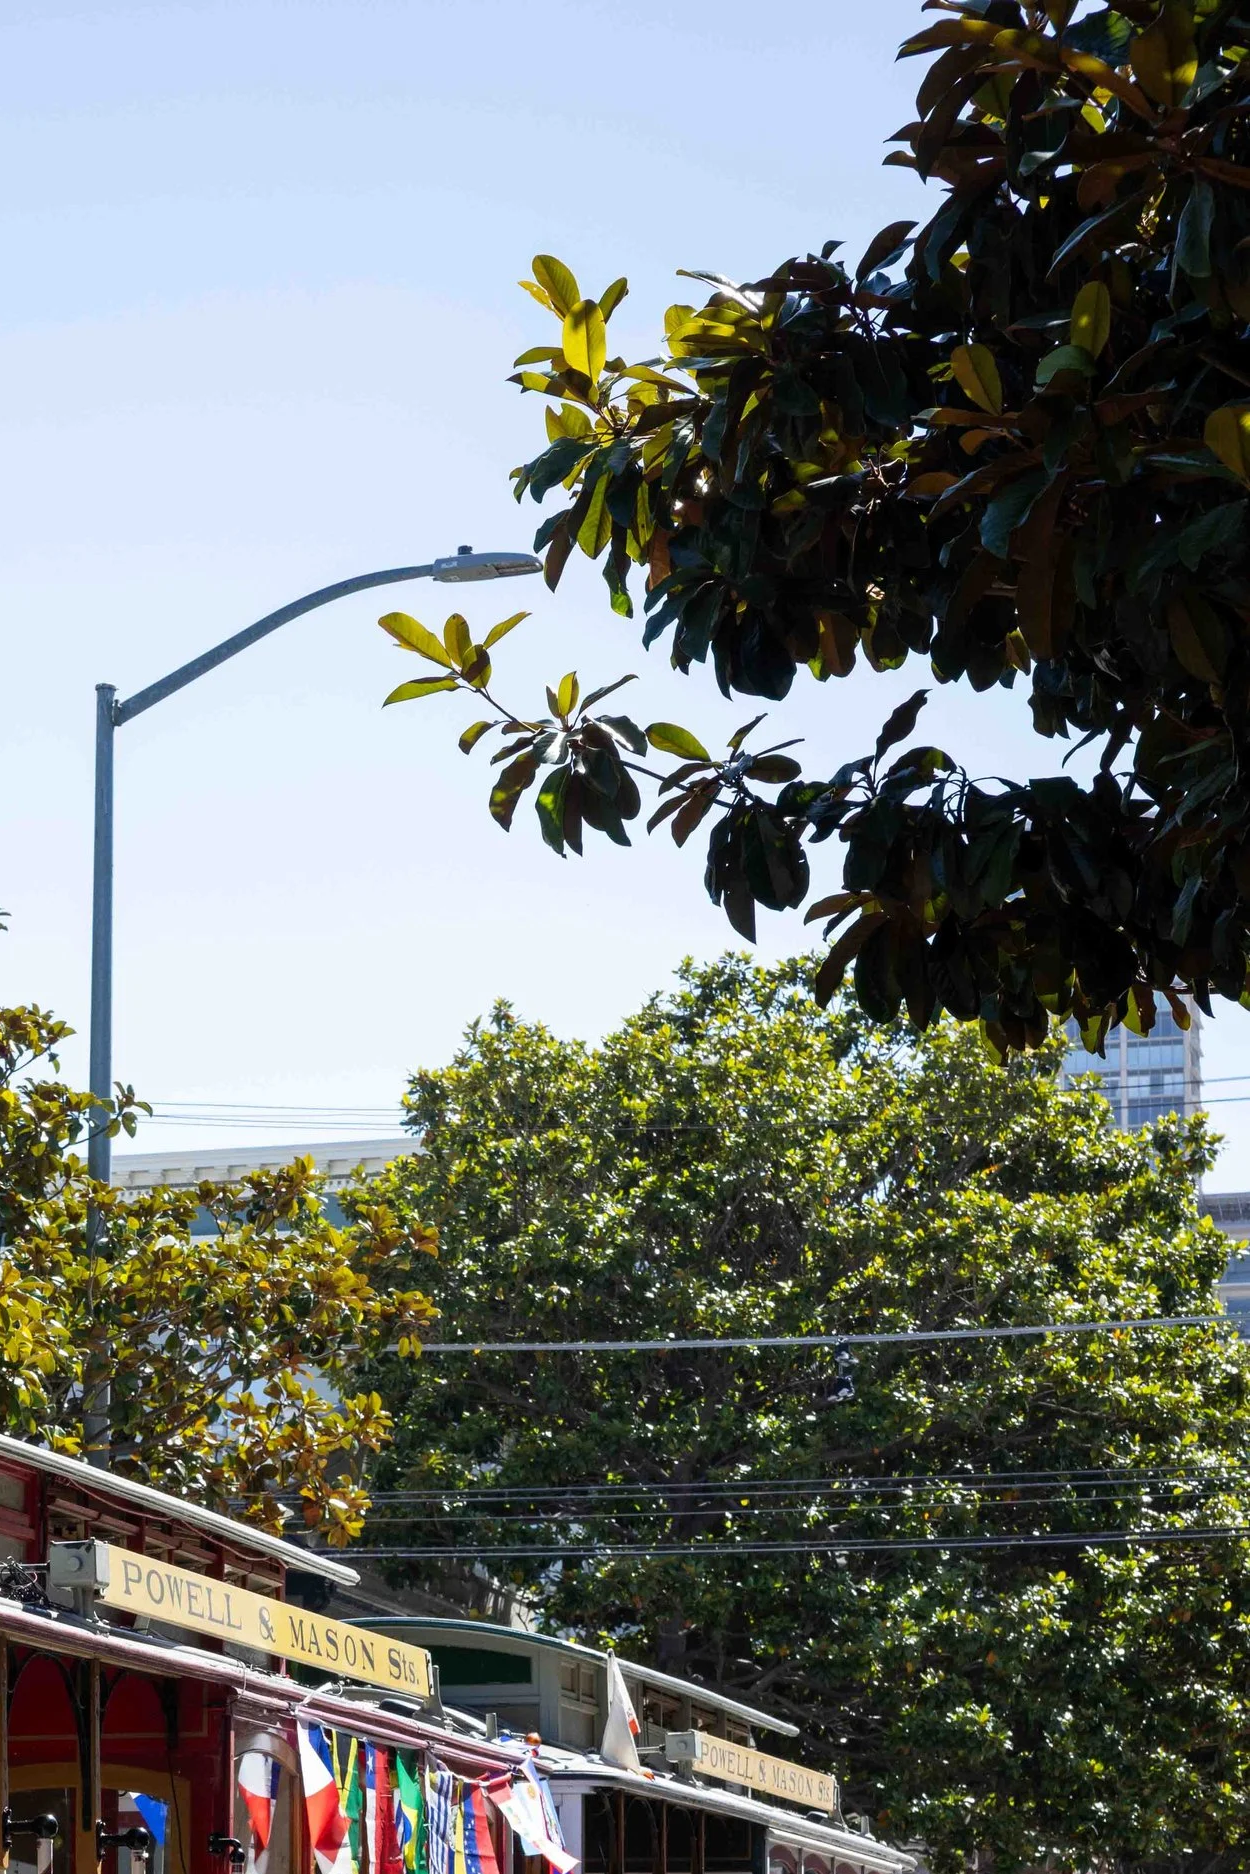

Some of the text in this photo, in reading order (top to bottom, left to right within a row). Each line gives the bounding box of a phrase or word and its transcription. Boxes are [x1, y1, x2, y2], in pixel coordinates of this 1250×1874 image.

[121, 1559, 420, 1685] POWELL & MASON Sts.
[700, 1741, 753, 1780] POWELL
[758, 1759, 767, 1784] &
[772, 1765, 813, 1798] MASON
